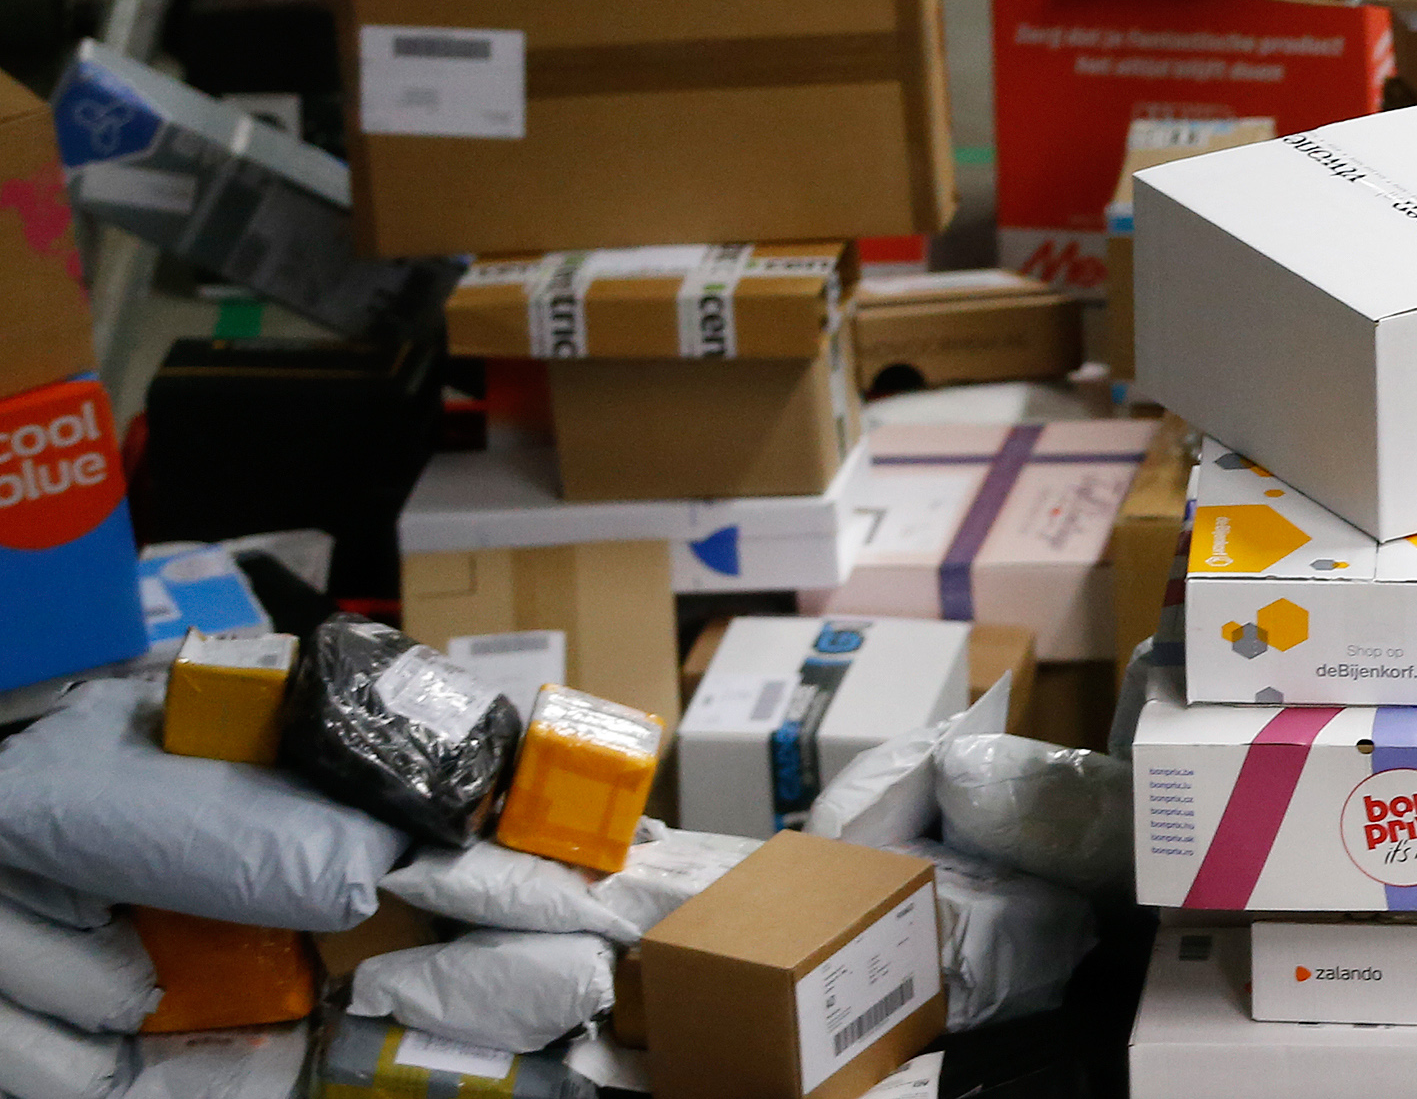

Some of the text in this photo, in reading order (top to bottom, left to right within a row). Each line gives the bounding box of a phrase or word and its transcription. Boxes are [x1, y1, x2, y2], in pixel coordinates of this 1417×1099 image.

[1282, 133, 1366, 184] vtwone
[1346, 644, 1405, 660] Shop op
[1315, 965, 1383, 981] zalando
